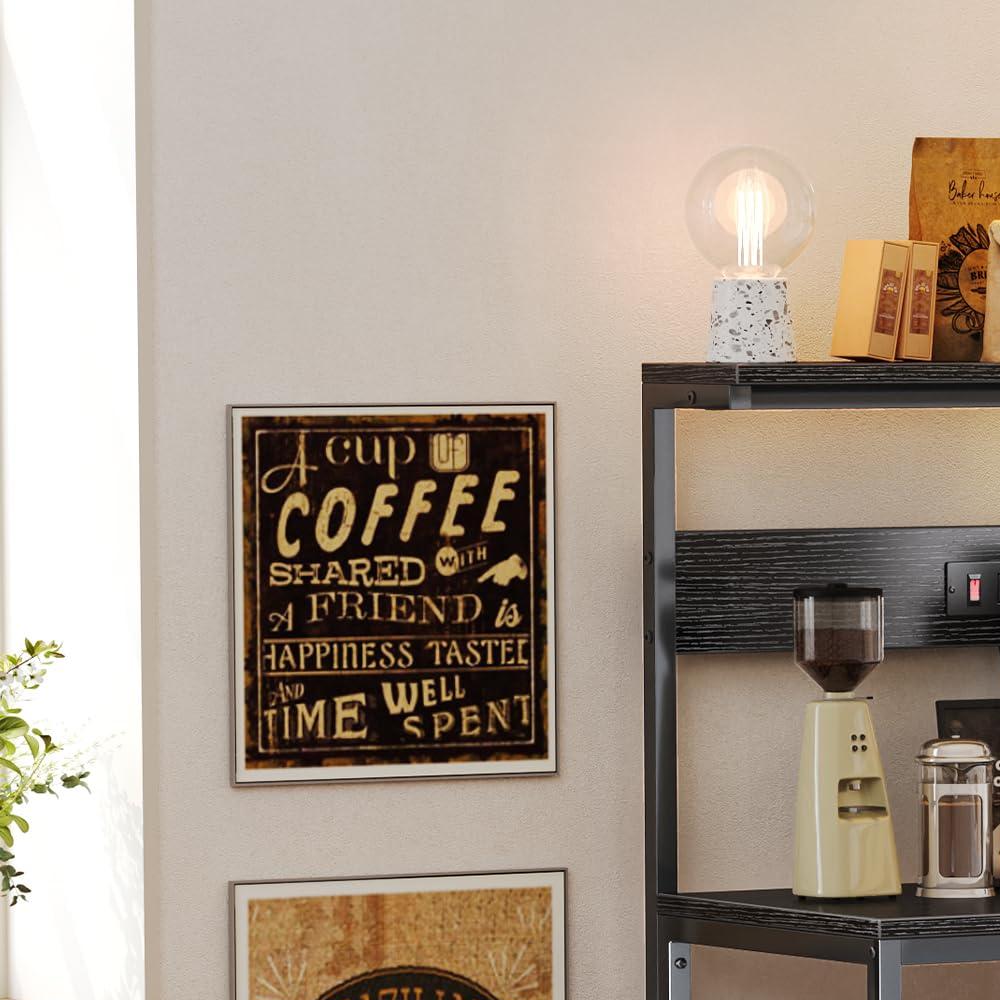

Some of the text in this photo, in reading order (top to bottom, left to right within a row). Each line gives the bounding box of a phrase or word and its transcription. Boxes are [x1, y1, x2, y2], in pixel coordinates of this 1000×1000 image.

[949, 180, 975, 200] Baker
[261, 431, 319, 494] A
[325, 434, 416, 480] cup
[276, 470, 521, 558] COFFEE
[269, 545, 489, 588] SHARED WITH
[268, 592, 523, 632] A FRIEND is
[269, 680, 305, 707] AND
[381, 674, 466, 715] WELL
[263, 693, 368, 741] TIME
[403, 694, 531, 739] SPENT
